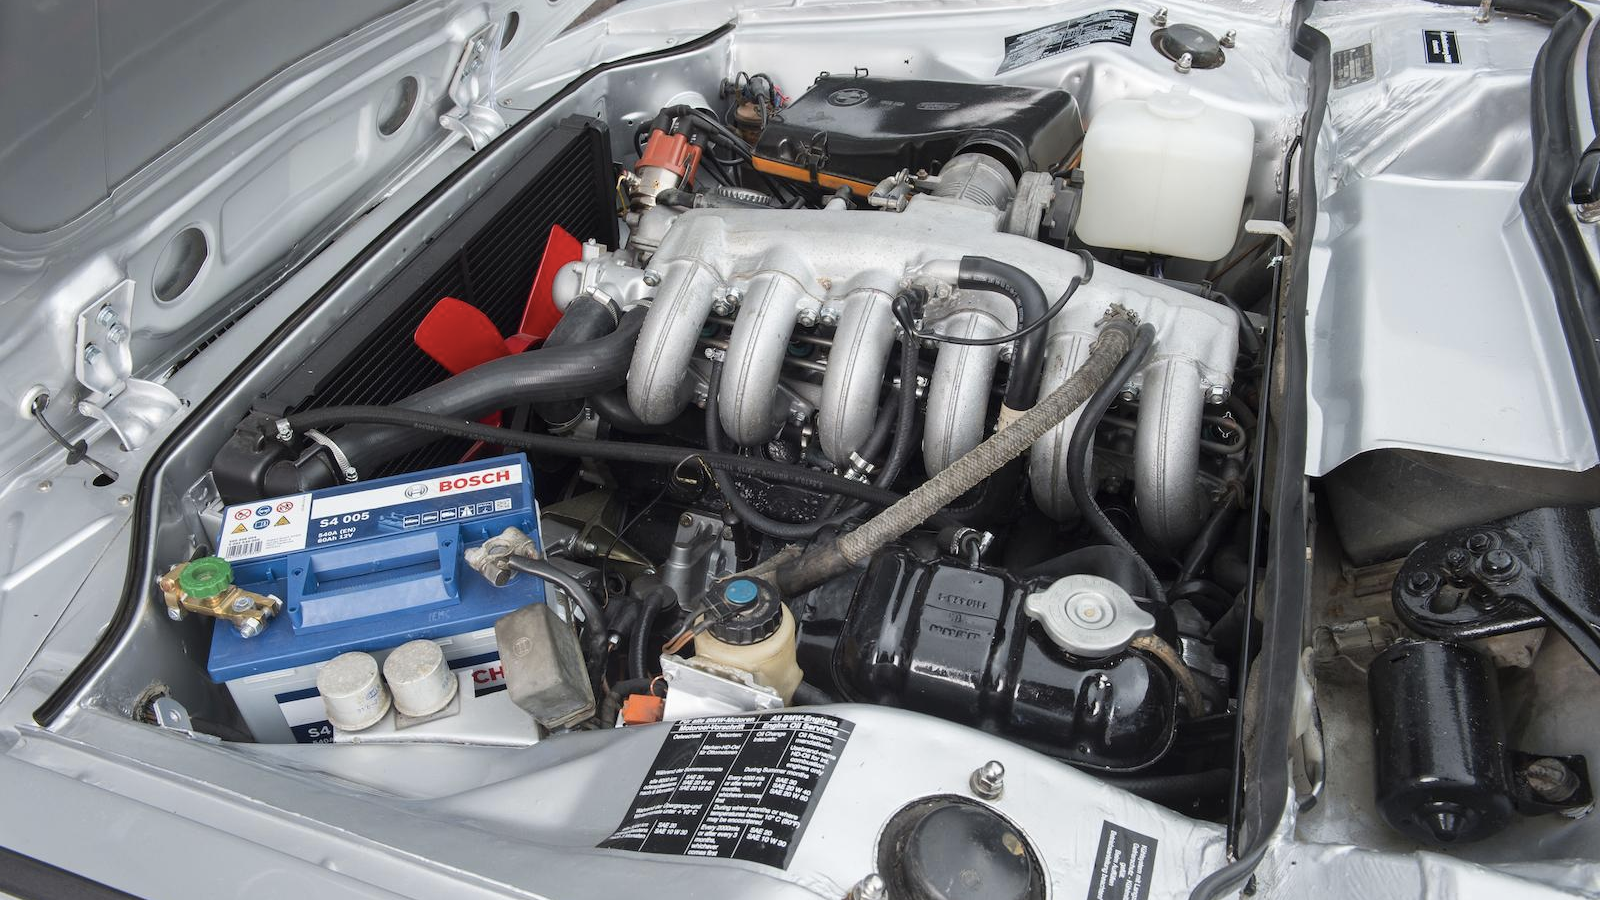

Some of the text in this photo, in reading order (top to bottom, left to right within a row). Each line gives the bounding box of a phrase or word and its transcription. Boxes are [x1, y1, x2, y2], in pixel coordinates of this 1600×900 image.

[439, 470, 510, 492] BOSCH
[320, 512, 370, 528] S4 005
[340, 526, 356, 535] (EN)
[318, 536, 337, 544] 60Ah
[782, 715, 838, 727] BMW-Engines
[308, 726, 331, 738] S4
[802, 723, 838, 736] Services
[807, 733, 832, 743] Recom-
[790, 751, 811, 759] HD-Oil
[786, 763, 824, 776] engines only
[790, 758, 825, 770] combustion
[786, 770, 810, 779] months
[779, 812, 799, 820] where
